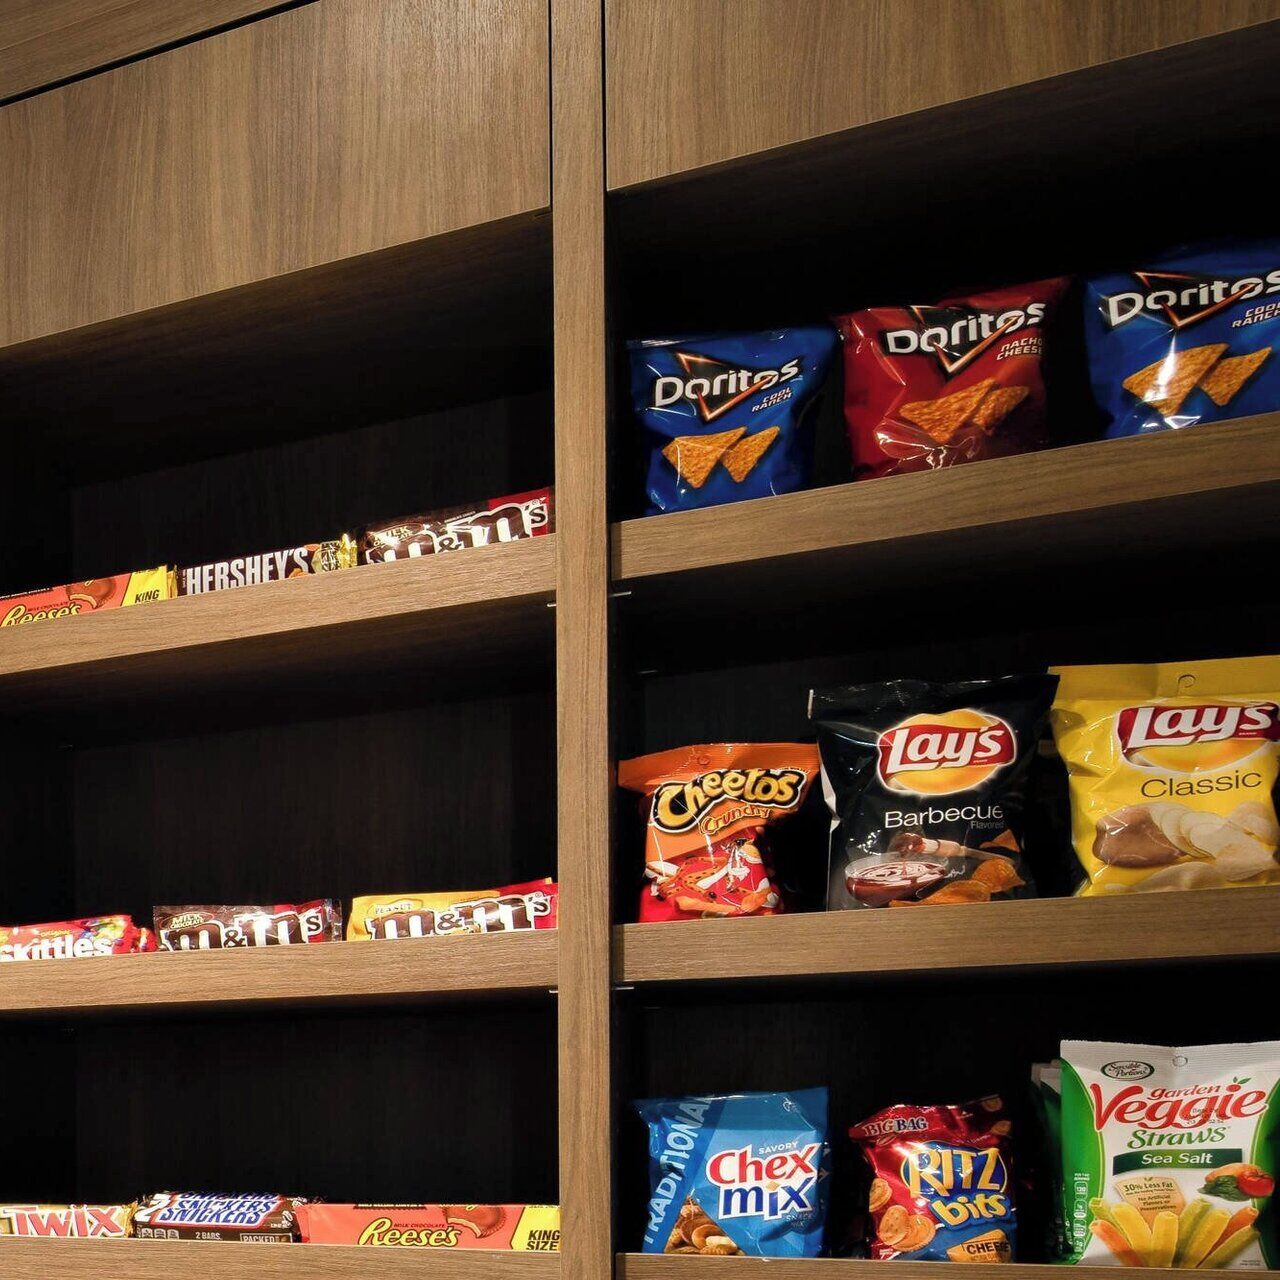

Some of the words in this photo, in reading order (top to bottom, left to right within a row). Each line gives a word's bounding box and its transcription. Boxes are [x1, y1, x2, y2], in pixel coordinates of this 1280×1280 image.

[886, 303, 1046, 354] Doritos
[655, 359, 800, 407] Doritos
[762, 386, 793, 403] COOL
[751, 393, 793, 413] RANCH
[186, 546, 310, 596] HERSHEY'S
[134, 589, 161, 604] KING
[0, 604, 82, 627] Reese's
[1126, 702, 1275, 750] Lay's
[885, 727, 1005, 775] Lay's
[1141, 769, 1263, 798] Classic
[657, 768, 802, 828] Cheetos
[703, 804, 772, 834] Crunchy
[884, 806, 1004, 829] Barbecue
[1147, 1084, 1220, 1101] garden
[1090, 1084, 1268, 1130] Veggie
[864, 1122, 893, 1137] BIG
[895, 1117, 928, 1131] BAG
[1127, 1126, 1227, 1150] Straws
[758, 1141, 799, 1155] SAVORY
[1142, 1154, 1172, 1165] Sea
[1178, 1153, 1214, 1165] Salt
[709, 1144, 821, 1185] Chex
[908, 1148, 1001, 1198] RITZ
[722, 1177, 814, 1217] mix
[932, 1194, 1007, 1226] bits
[158, 1208, 263, 1225] SNICKERS
[242, 1235, 276, 1244] PACKED
[358, 1217, 462, 1248] Reese's
[528, 1229, 559, 1241] KING
[526, 1240, 559, 1252] SIZE
